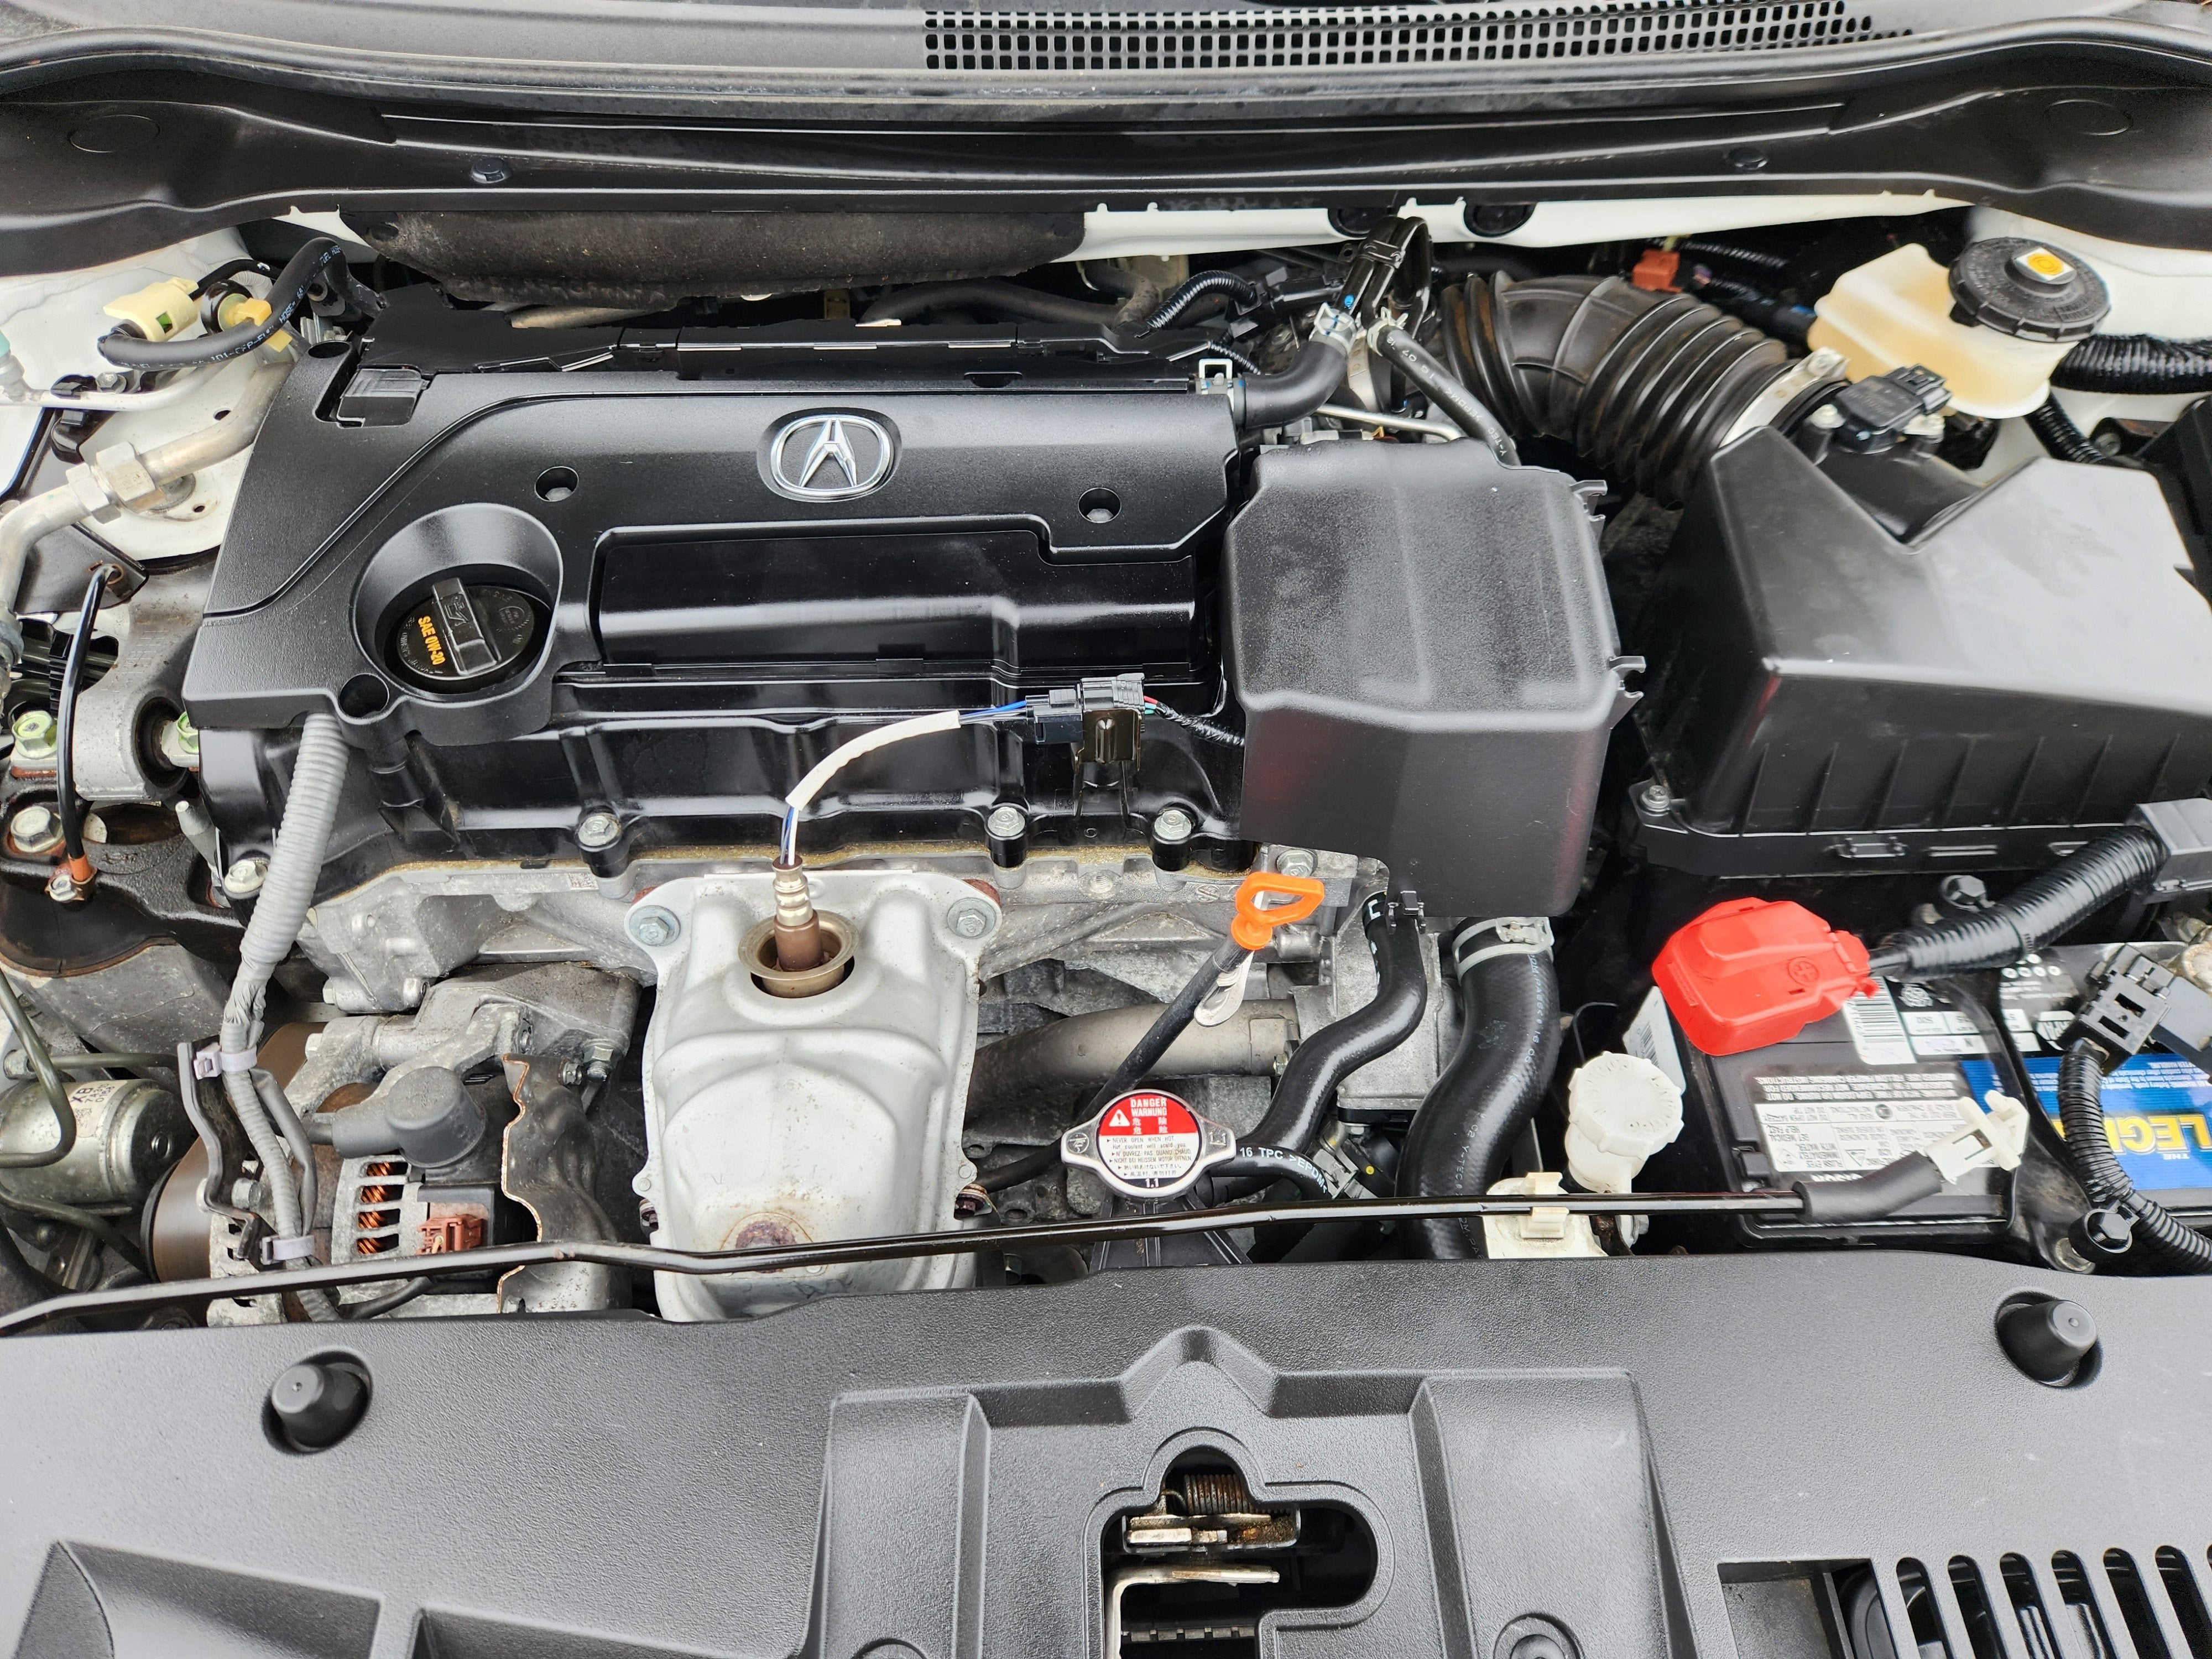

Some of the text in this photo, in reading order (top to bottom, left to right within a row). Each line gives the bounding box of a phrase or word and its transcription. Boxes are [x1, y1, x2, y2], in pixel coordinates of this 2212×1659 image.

[418, 615, 446, 665] SAE 0W-20
[1130, 1098, 1167, 1108] DANGER
[1131, 1107, 1167, 1117] WARNUNG
[1239, 1147, 1253, 1157] 16
[1258, 1147, 1284, 1160] TPC
[1145, 1178, 1159, 1188] 1.1
